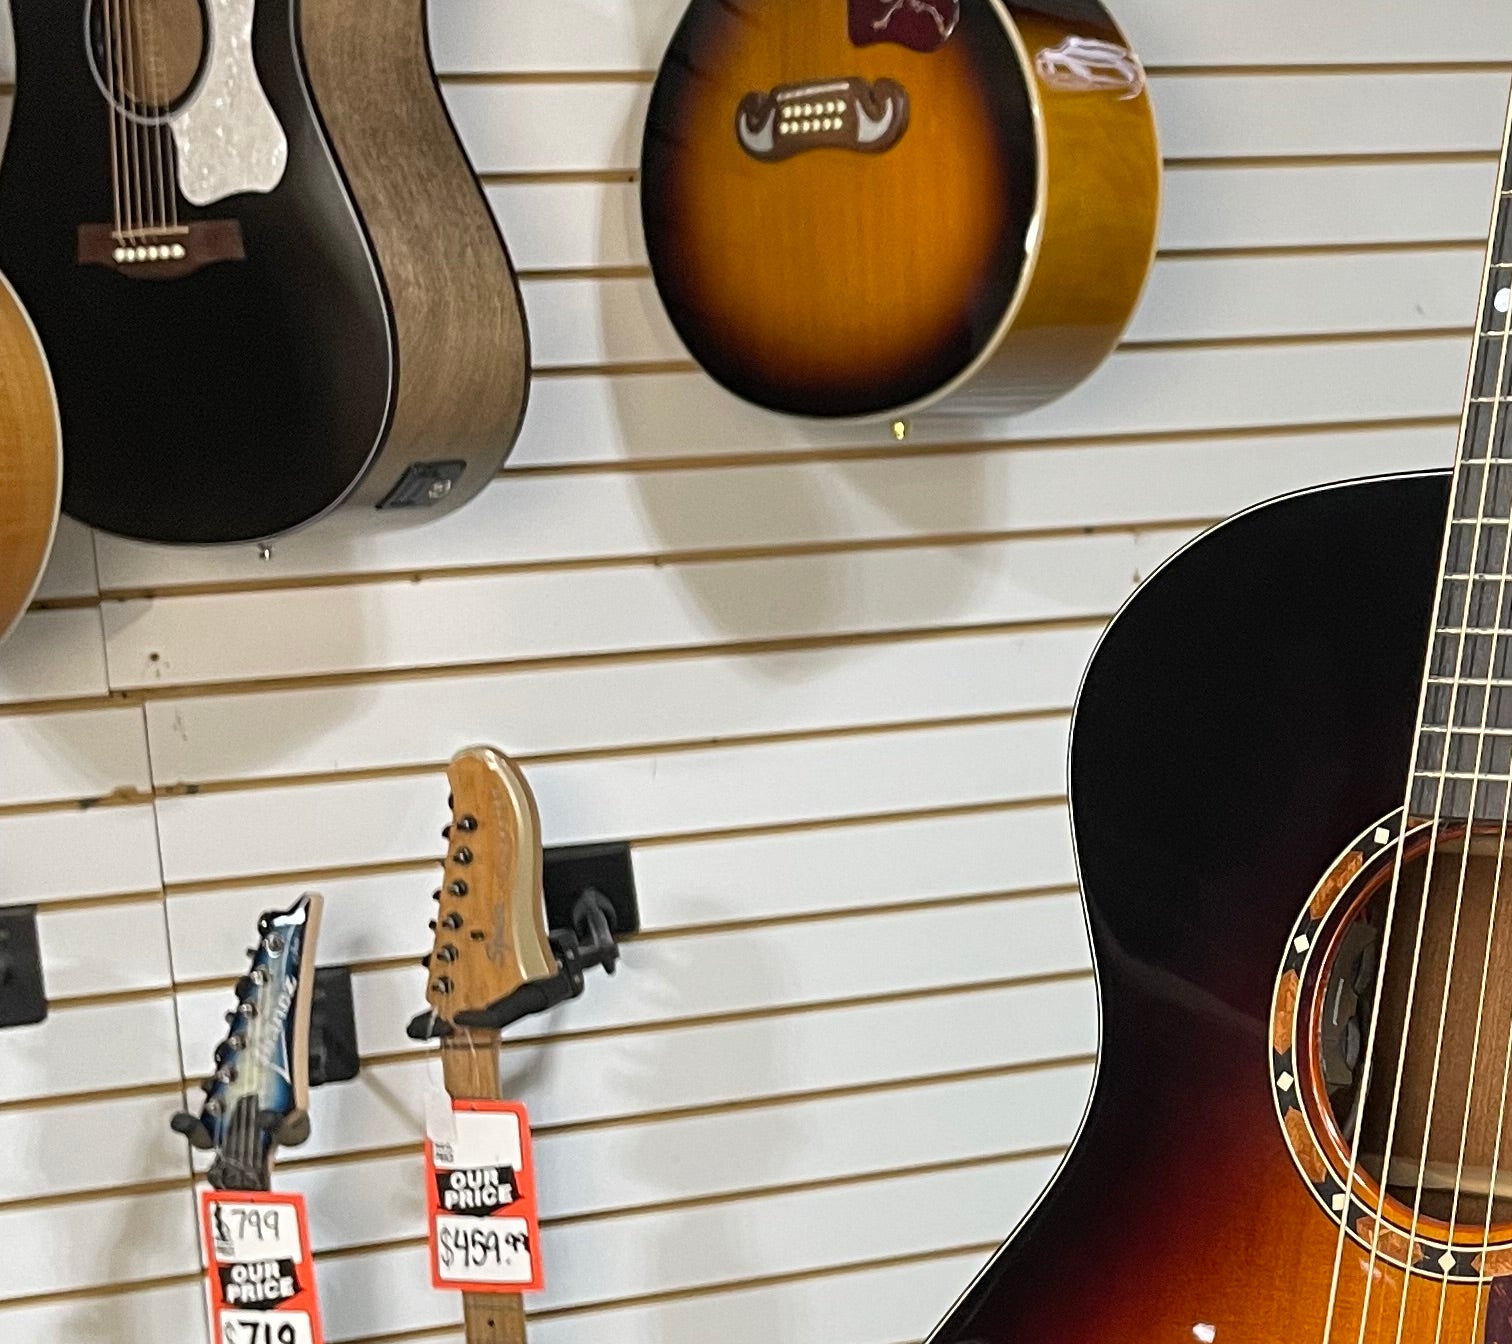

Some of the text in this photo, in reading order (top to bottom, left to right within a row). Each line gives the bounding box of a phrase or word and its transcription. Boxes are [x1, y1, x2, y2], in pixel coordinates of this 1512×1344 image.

[450, 1168, 500, 1191] OUR
[444, 1183, 515, 1210] PRICE
[230, 1260, 281, 1283] OUR
[226, 1276, 296, 1304] PRICE
